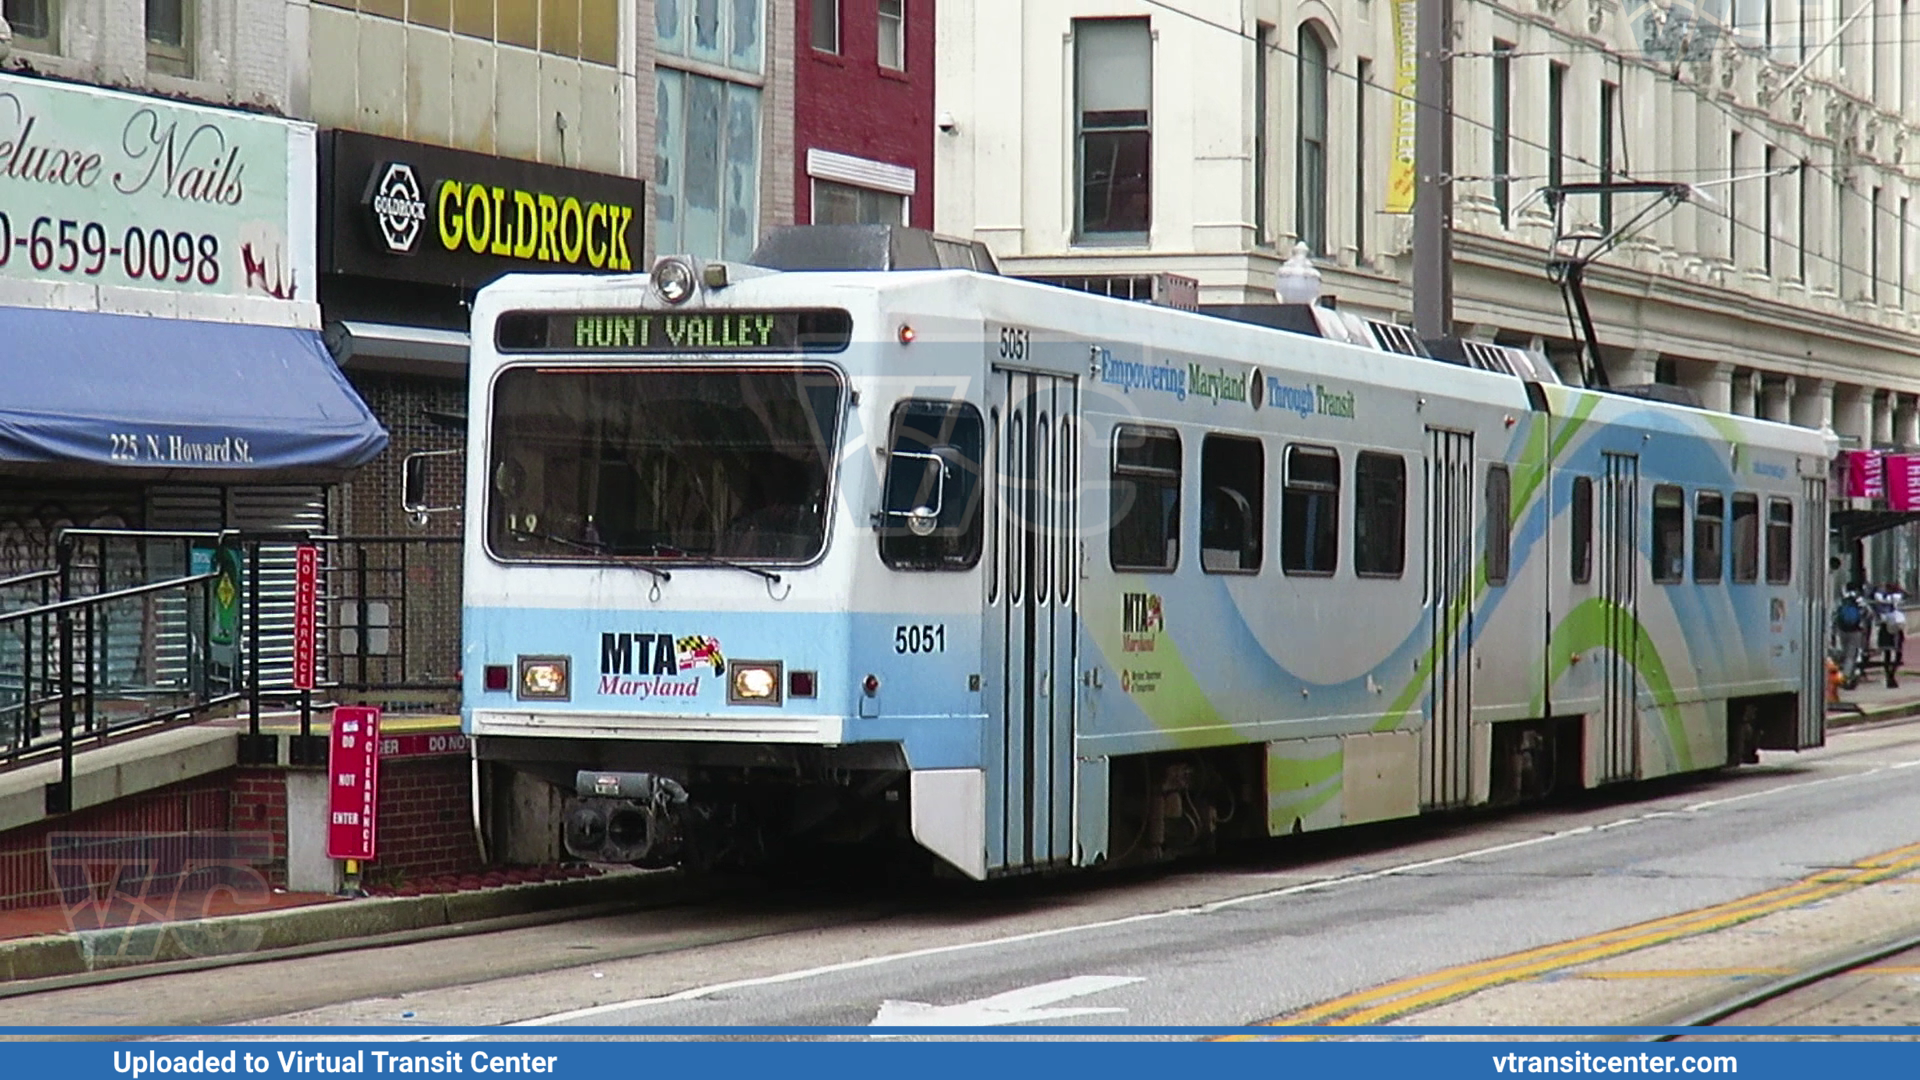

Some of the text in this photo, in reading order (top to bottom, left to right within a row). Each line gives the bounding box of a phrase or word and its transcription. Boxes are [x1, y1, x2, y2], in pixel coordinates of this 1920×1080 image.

[0, 93, 244, 205] eluxe Nails
[374, 195, 426, 220] GOLDROCK
[438, 180, 632, 271] GOLDROCK
[576, 315, 774, 346] HUNT VALLEY
[1000, 327, 1030, 360] 5051
[1101, 350, 1355, 419] Empowering Maryland Through Transit
[110, 433, 254, 463] 225 N. Howard St.
[300, 553, 311, 684] NO CLEARANCE
[1122, 592, 1148, 633] MTA
[601, 632, 678, 676] MTA
[895, 623, 945, 655] 5051
[597, 675, 700, 701] Maryland
[342, 735, 355, 748] DO
[429, 735, 446, 751] DO
[448, 735, 470, 750] NO
[338, 774, 356, 787] NOT
[363, 713, 375, 852] NO CLEARANCE
[333, 812, 359, 825] ENTER
